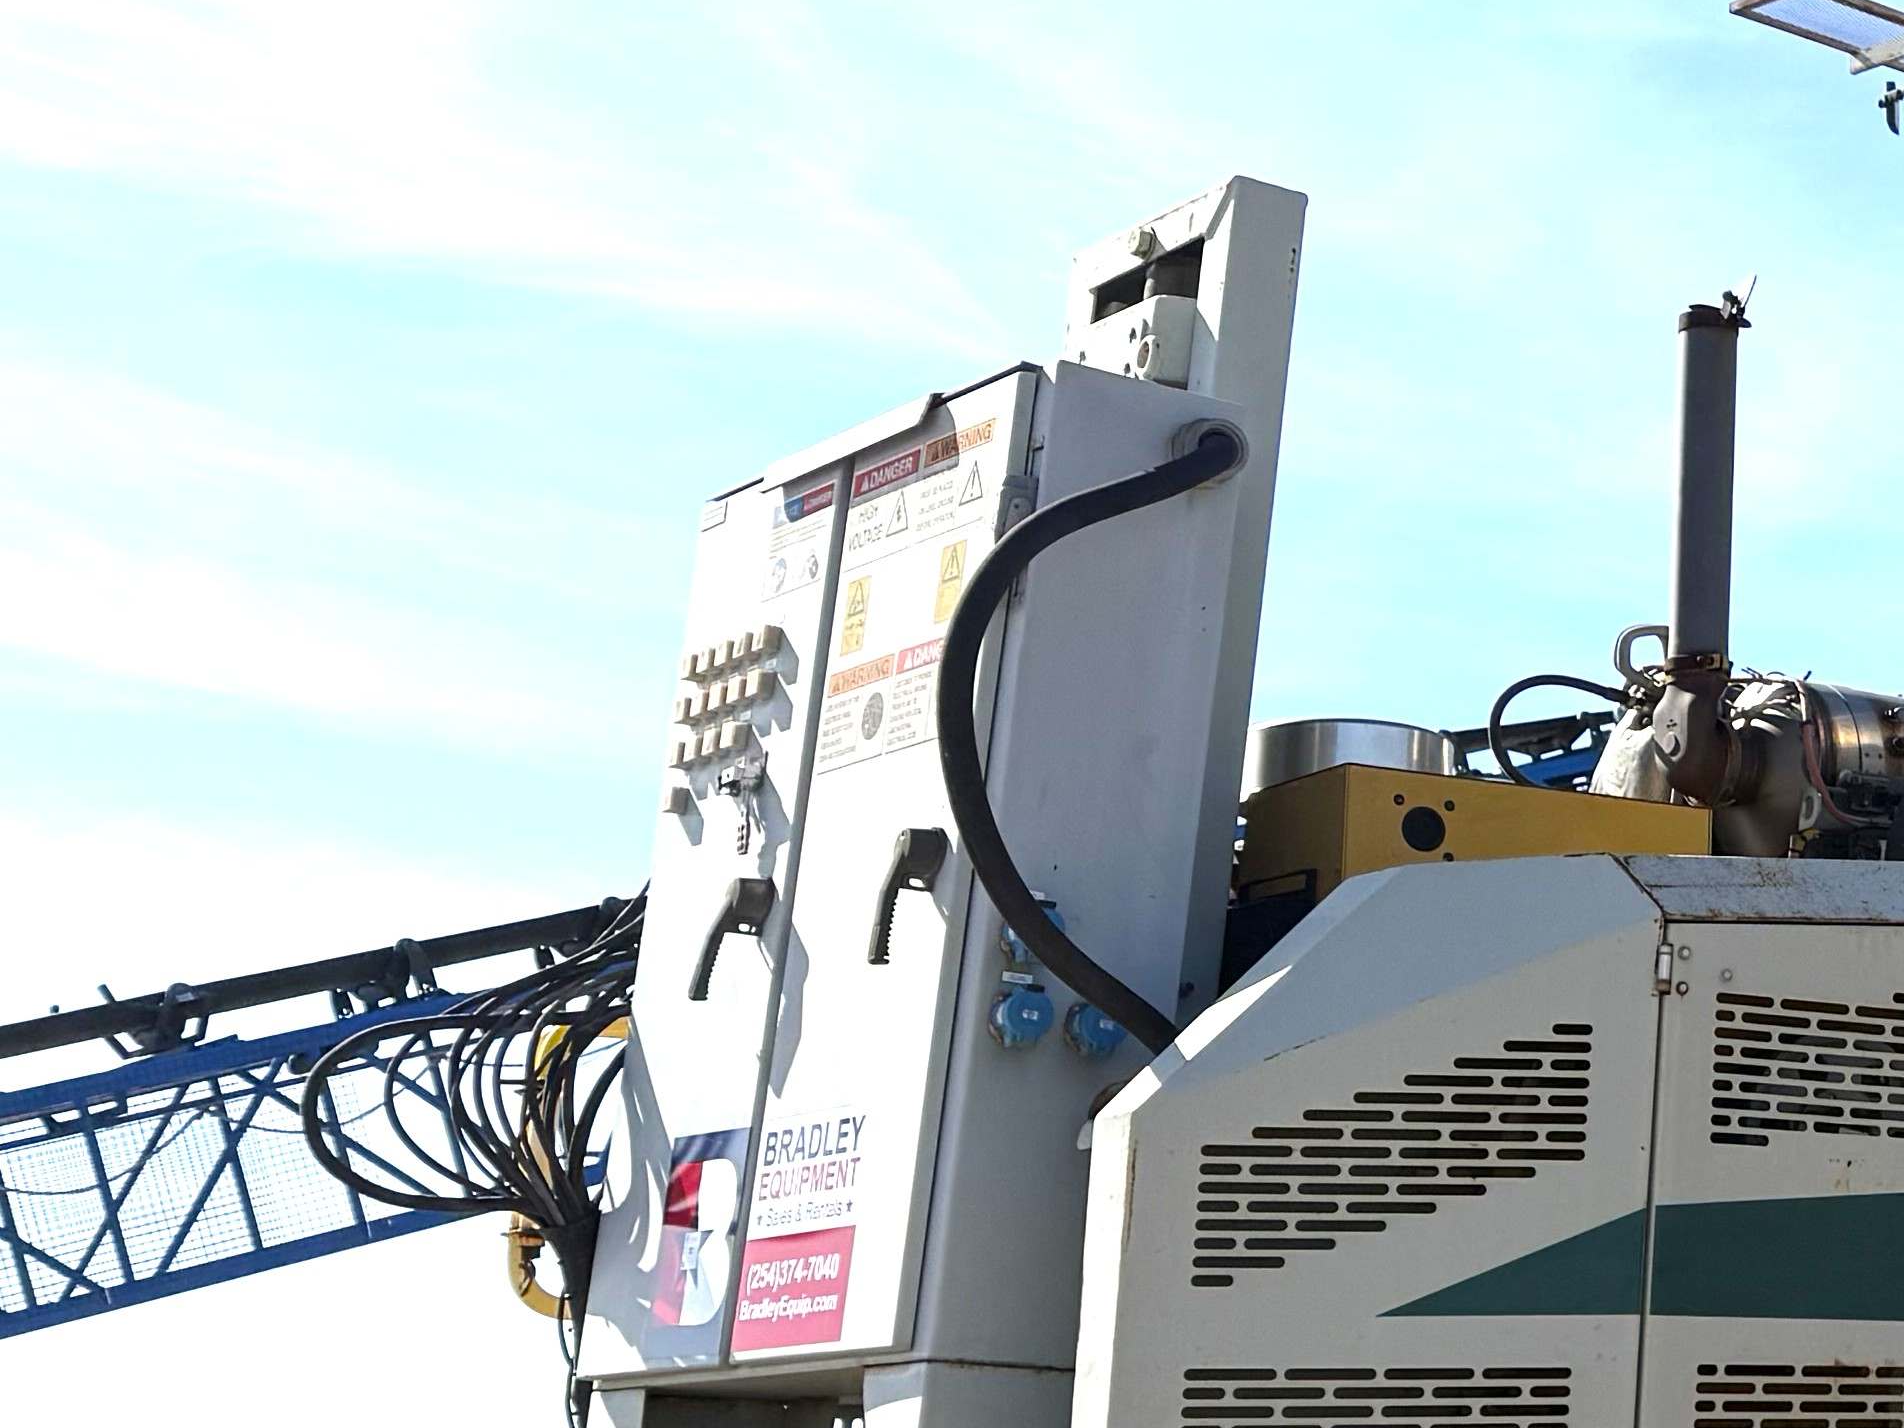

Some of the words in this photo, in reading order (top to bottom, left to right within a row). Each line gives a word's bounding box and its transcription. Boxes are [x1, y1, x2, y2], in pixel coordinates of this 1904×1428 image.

[763, 1114, 867, 1167] BRADLEY
[757, 1156, 862, 1202] EQUIPMENT
[746, 1253, 841, 1296] (254)374-7040
[738, 1293, 838, 1323] BradleyEquip.com
